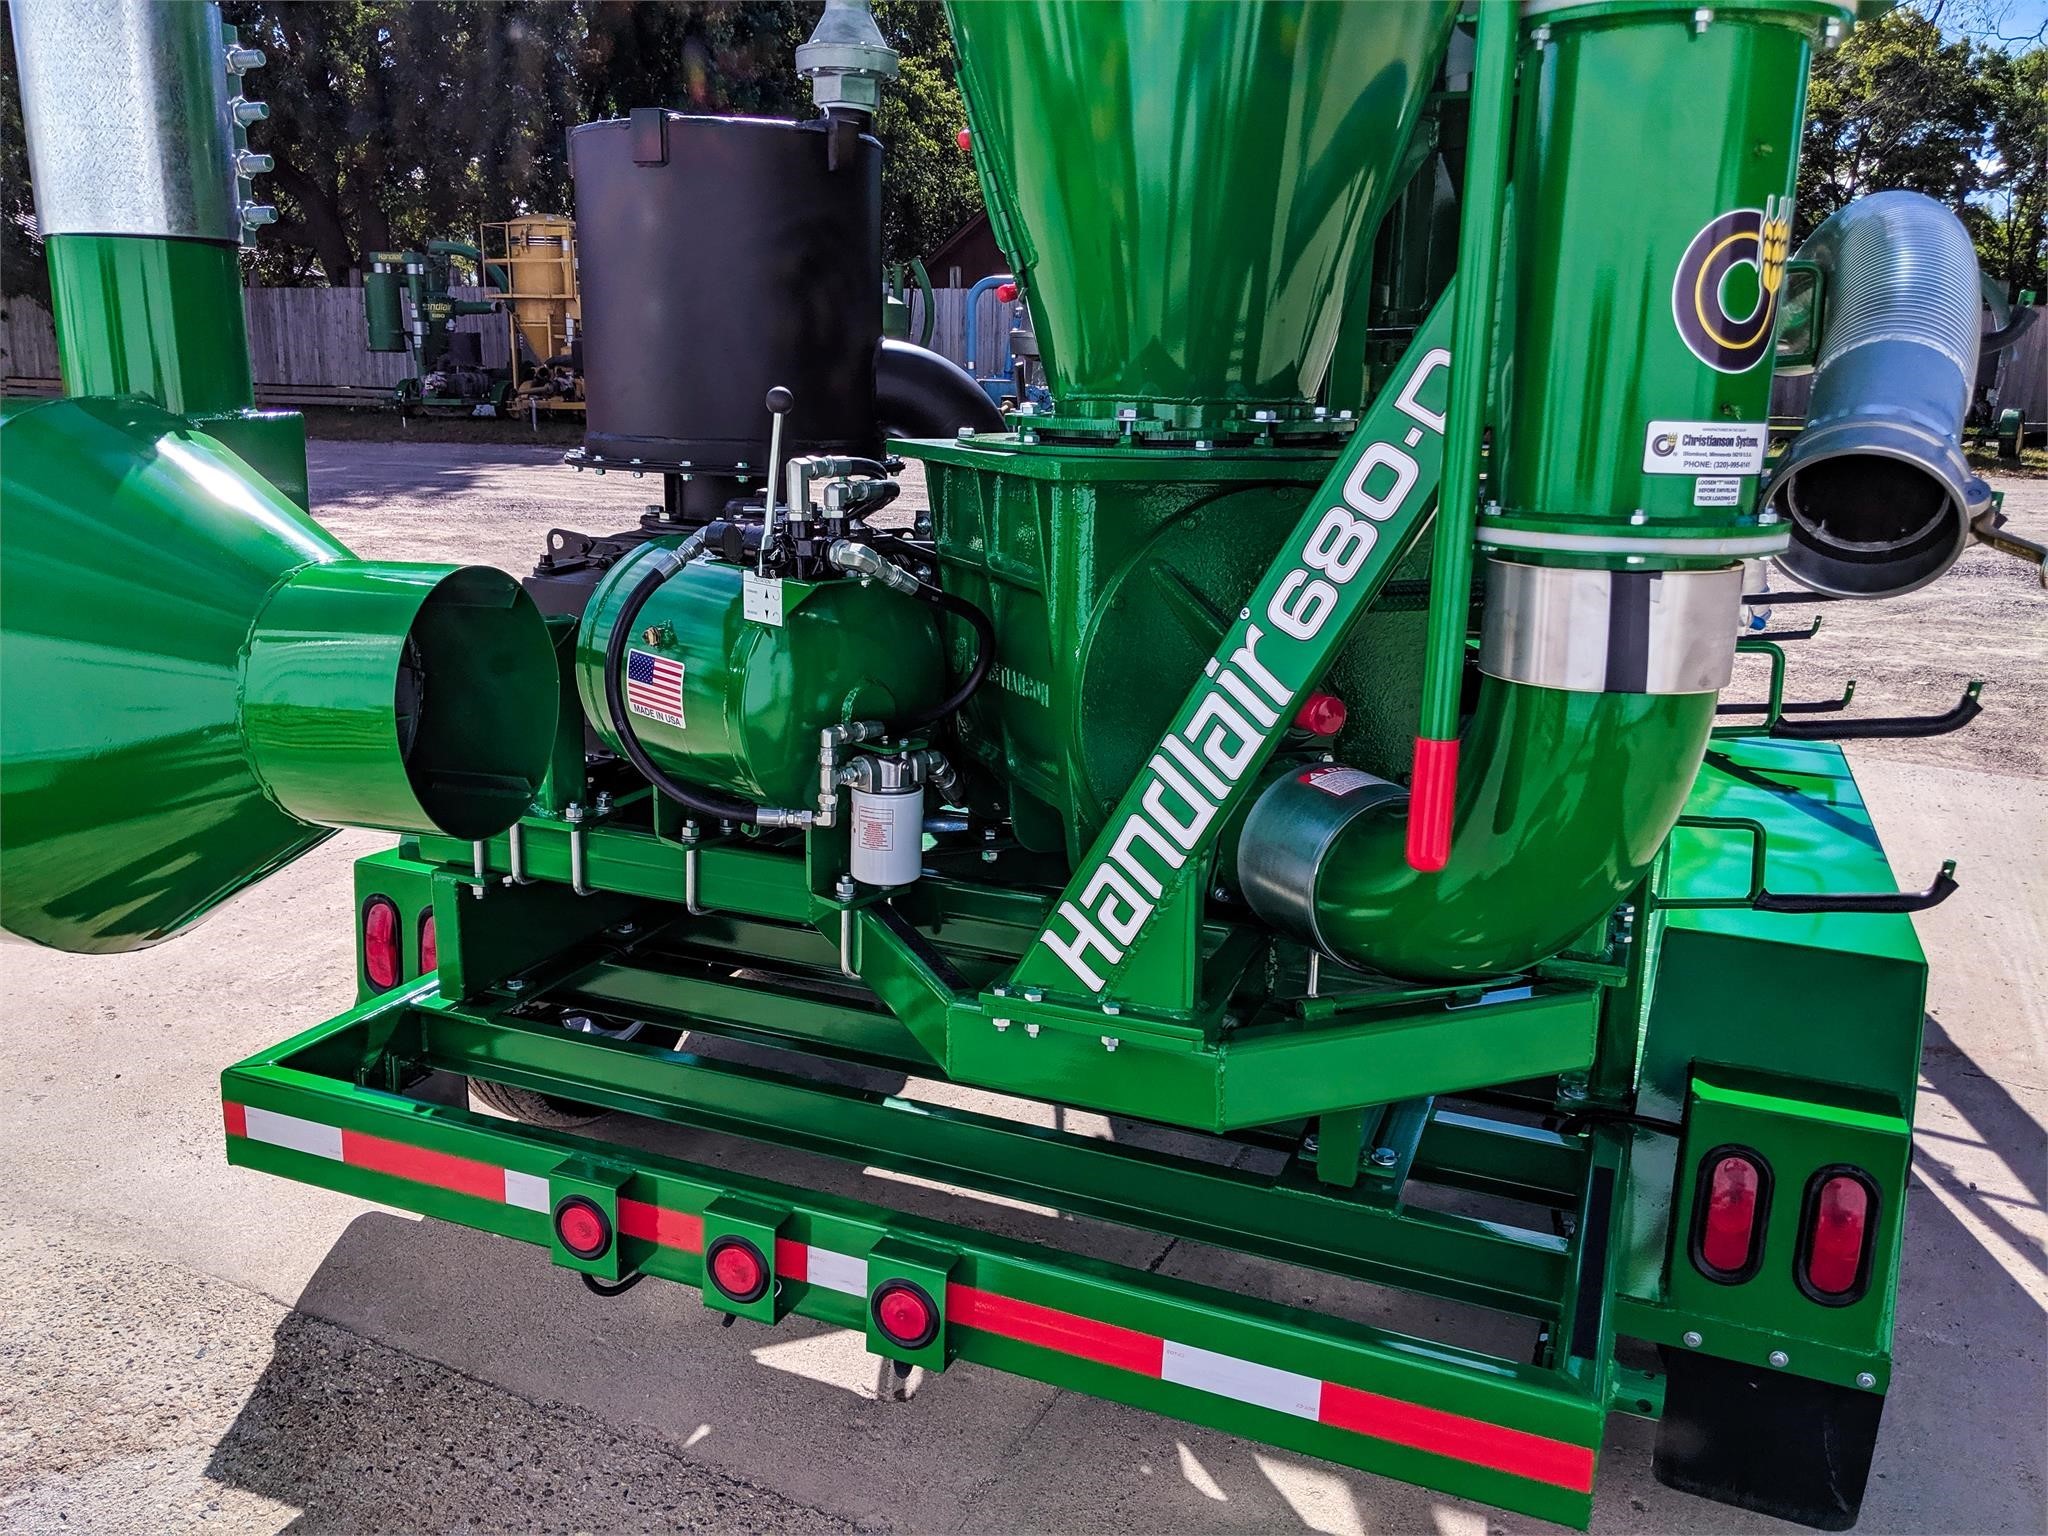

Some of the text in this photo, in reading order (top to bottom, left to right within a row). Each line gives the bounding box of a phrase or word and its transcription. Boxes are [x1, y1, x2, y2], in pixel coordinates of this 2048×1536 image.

[1682, 434, 1734, 447] Christianson
[633, 704, 681, 726] MADE IN USA
[1041, 622, 1297, 993] Handlair
